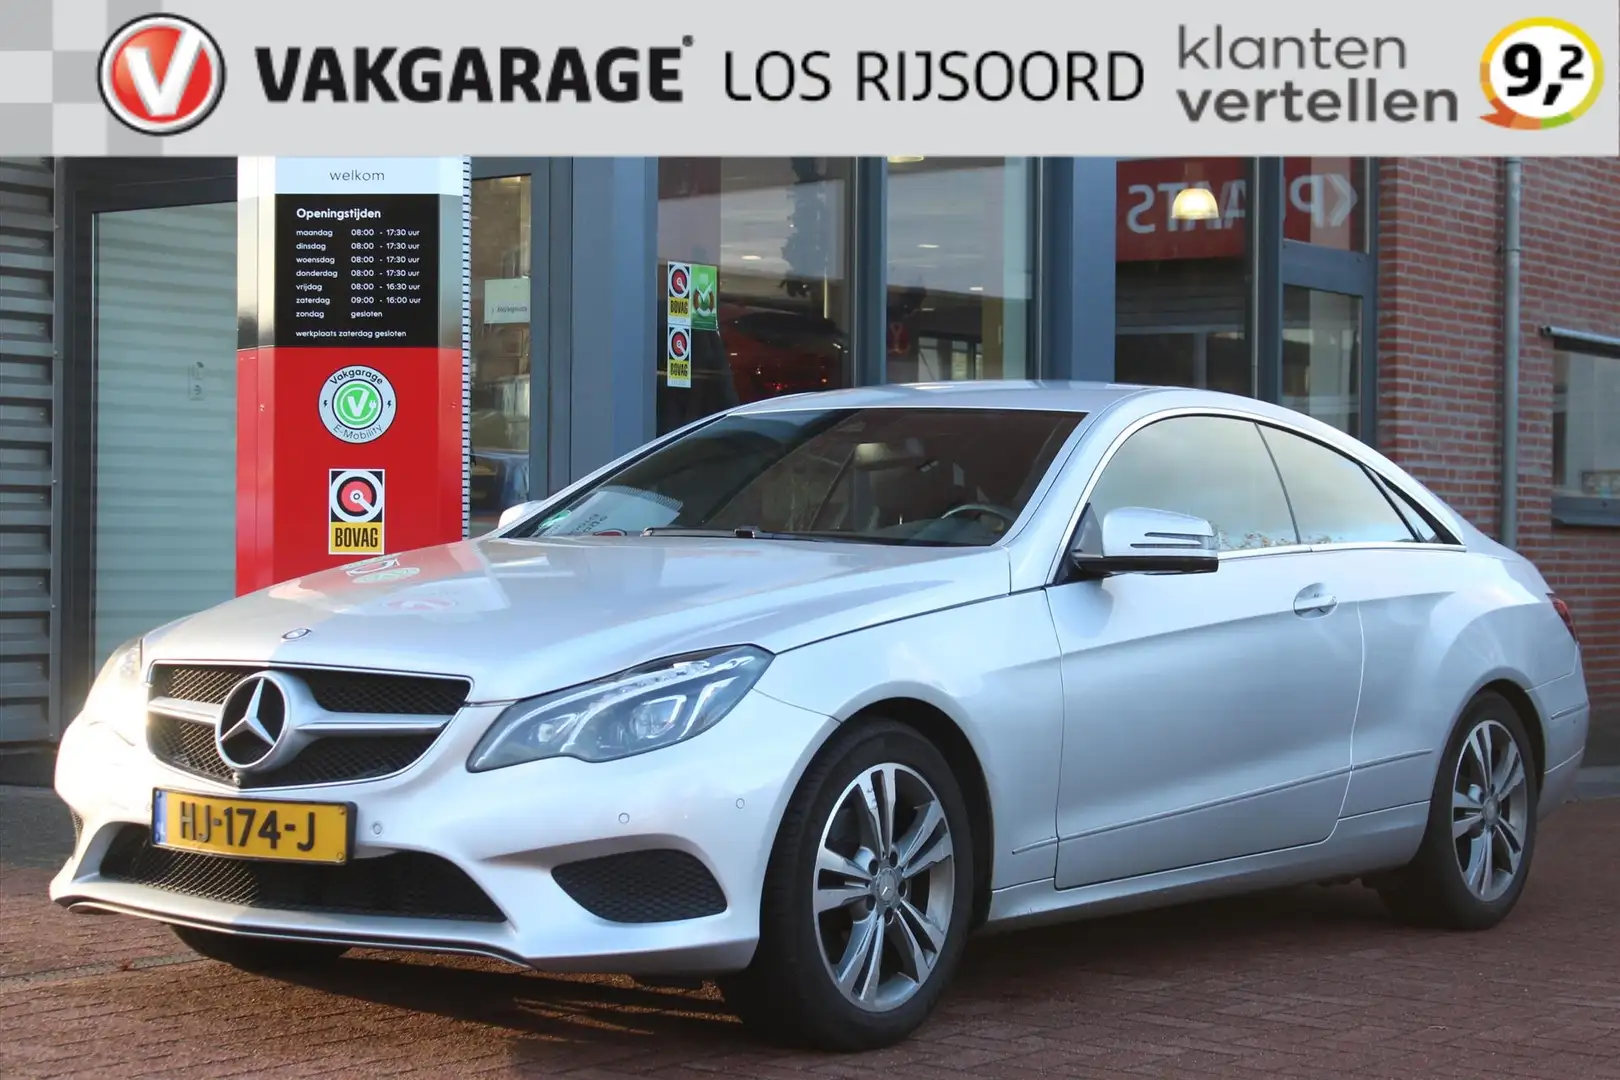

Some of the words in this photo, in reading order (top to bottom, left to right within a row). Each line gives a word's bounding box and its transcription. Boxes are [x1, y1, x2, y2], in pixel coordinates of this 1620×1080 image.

[329, 169, 385, 182] welkom
[296, 208, 381, 221] Openingstijden
[296, 228, 333, 238] maandag
[351, 229, 375, 237] 08:00
[386, 229, 407, 237] 17:30
[296, 242, 327, 252] dinsdag
[351, 242, 375, 250] 08:00
[386, 242, 407, 250] 17:30
[296, 256, 336, 265] woensdag
[351, 256, 375, 264] 08:00
[386, 256, 407, 264] 17:30
[296, 269, 338, 279] donderdag
[351, 269, 375, 277] 08:00
[386, 269, 407, 277] 17:30
[296, 282, 323, 292] vrijdag
[351, 283, 375, 291] 08:00
[386, 283, 407, 291] 16:30
[296, 296, 331, 306] zaterdag
[351, 296, 375, 304] 09:00
[386, 296, 407, 304] 16:00
[670, 300, 688, 315] BOVAG
[295, 310, 325, 319] zondag
[351, 310, 383, 319] gesloten
[295, 329, 337, 339] werkplaats
[338, 329, 373, 339] zaterdag
[374, 329, 407, 339] gesloten
[670, 362, 688, 377] BOVAG
[329, 369, 383, 385] Vakgarage
[333, 424, 382, 440] E-Mobility
[334, 527, 379, 548] BOVAG
[179, 800, 316, 852] HJ-174-J
